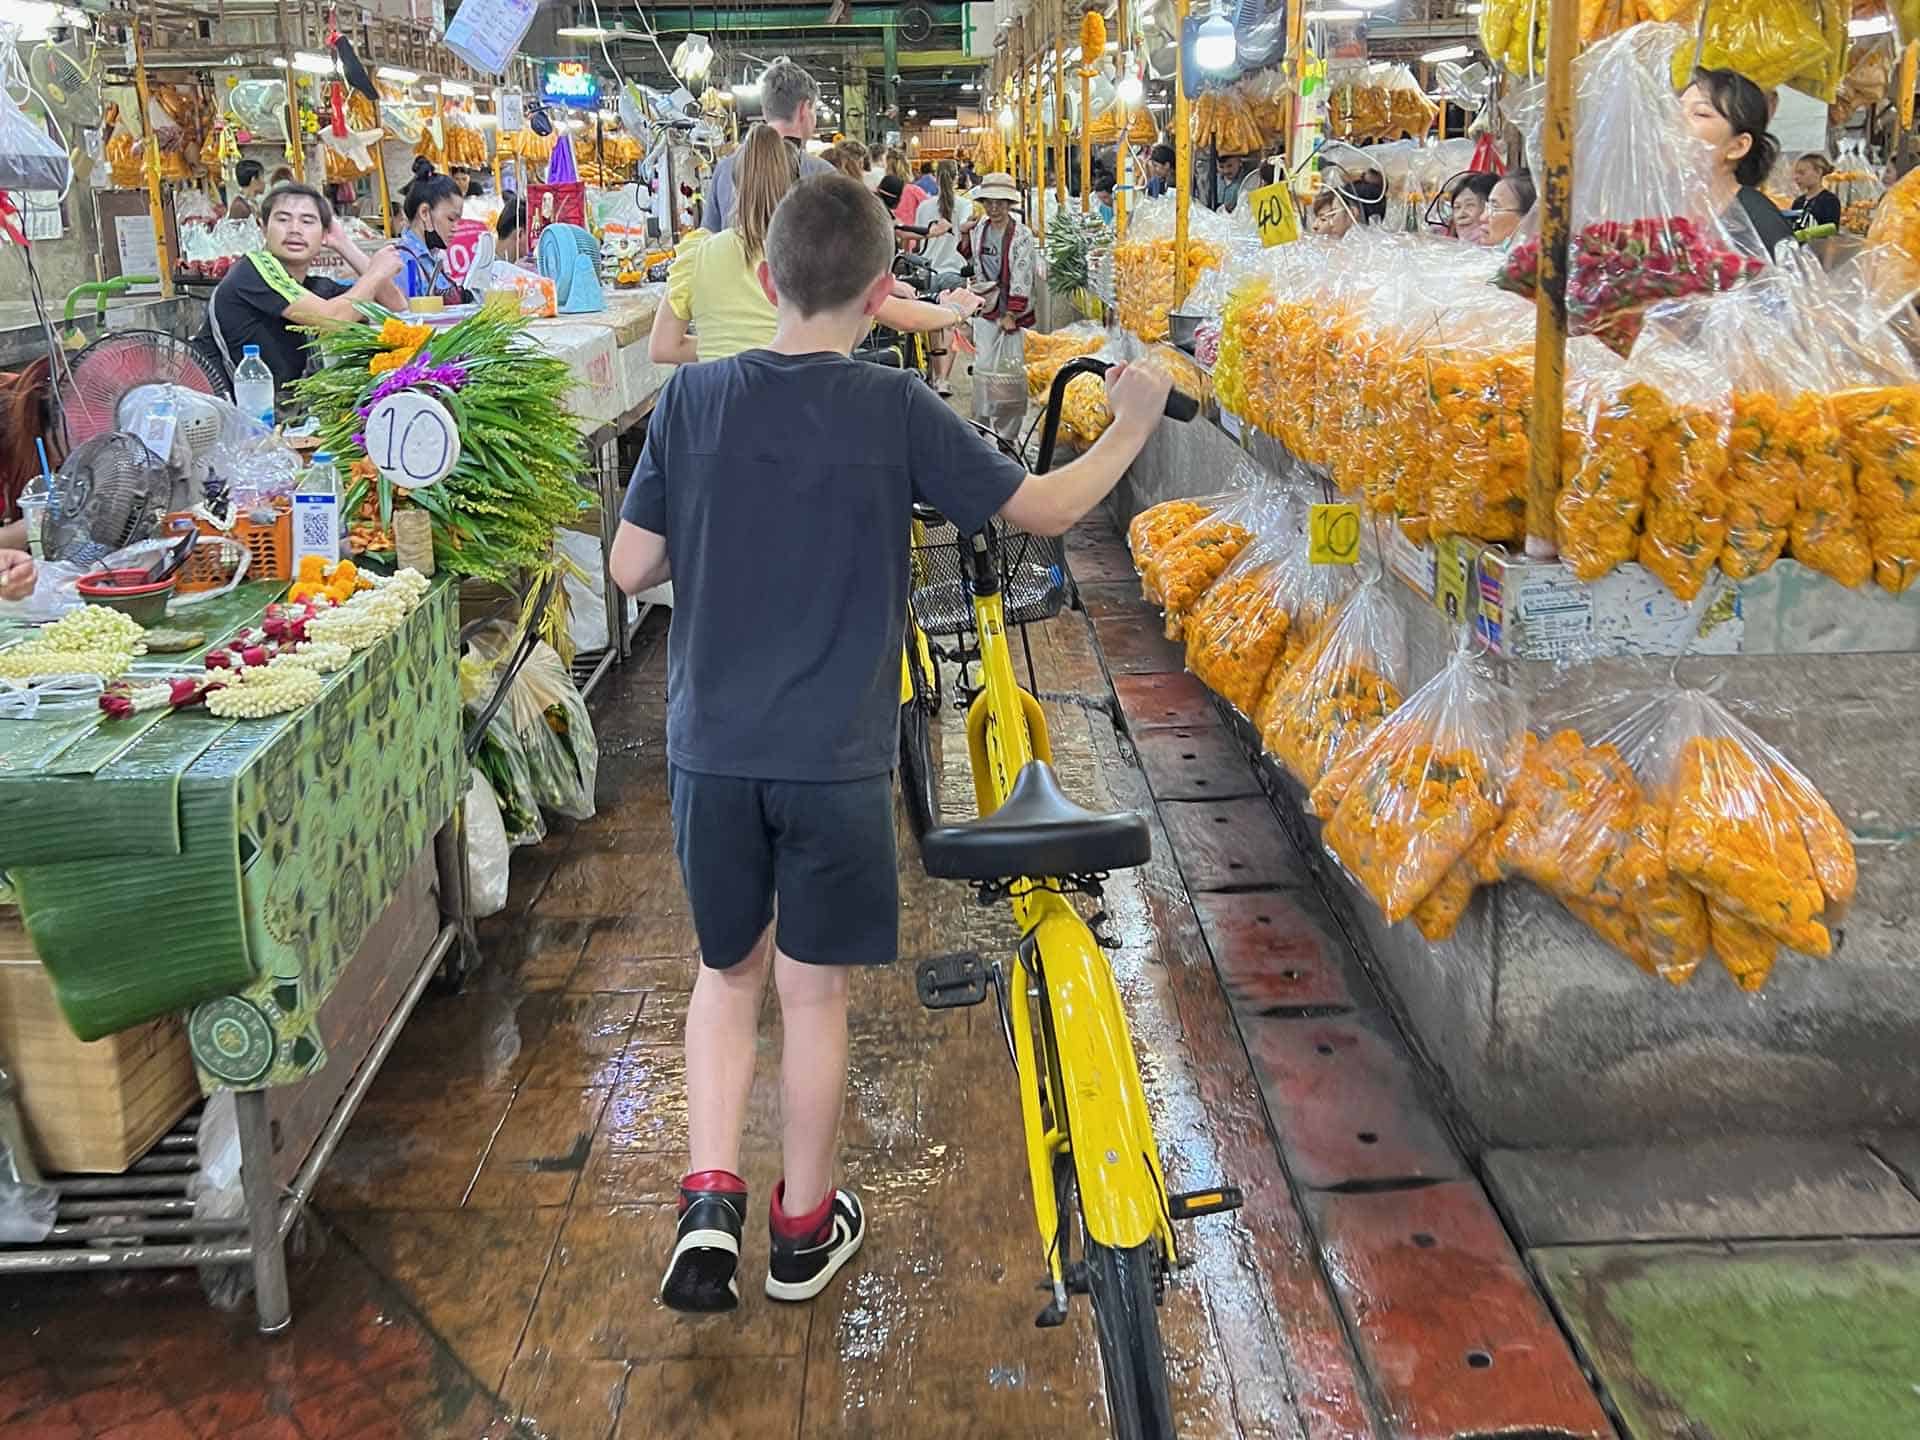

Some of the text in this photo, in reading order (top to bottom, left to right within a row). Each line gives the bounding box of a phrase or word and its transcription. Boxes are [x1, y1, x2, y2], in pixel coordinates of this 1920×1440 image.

[1258, 194, 1282, 235] 40
[381, 407, 449, 480] 10
[1316, 508, 1360, 557] 10
